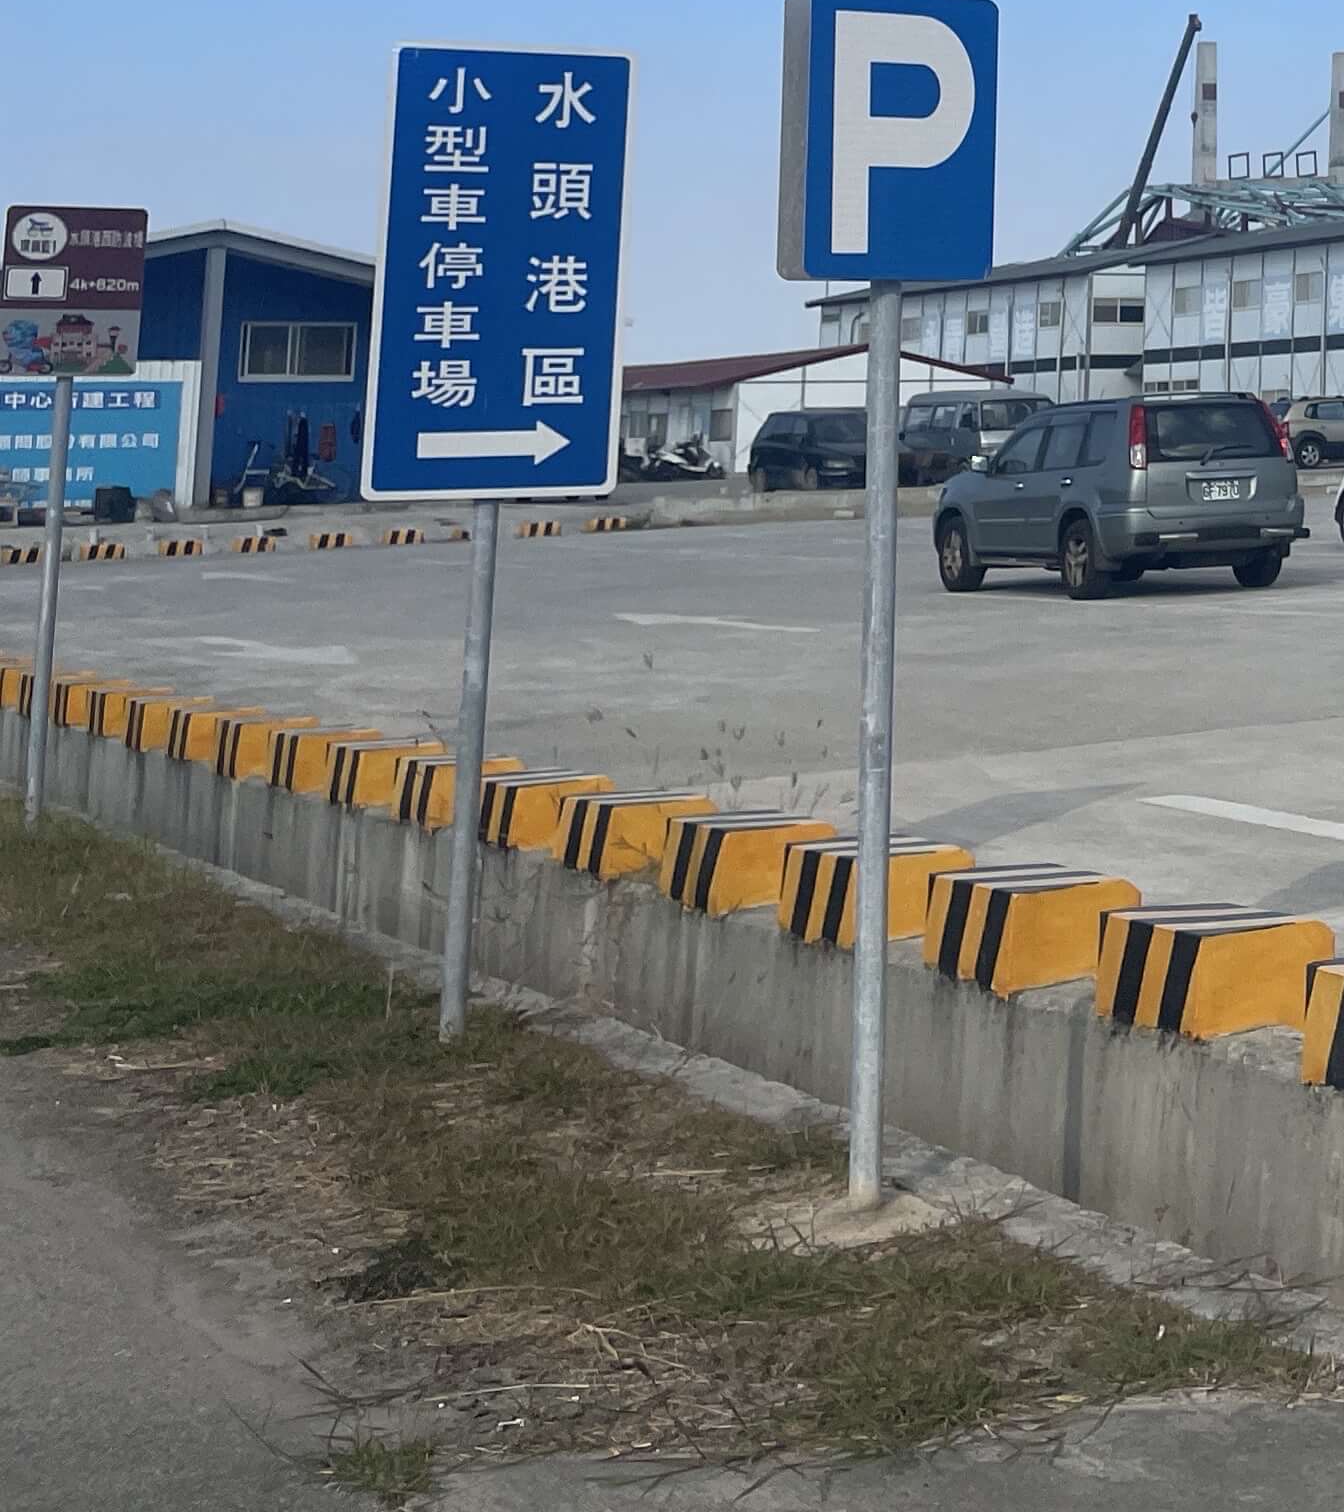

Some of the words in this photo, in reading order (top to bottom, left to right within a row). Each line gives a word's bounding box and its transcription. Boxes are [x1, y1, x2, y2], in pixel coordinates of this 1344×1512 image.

[411, 67, 492, 408] 小型車停車場
[521, 71, 597, 406] 水頭港區
[831, 9, 976, 254] P
